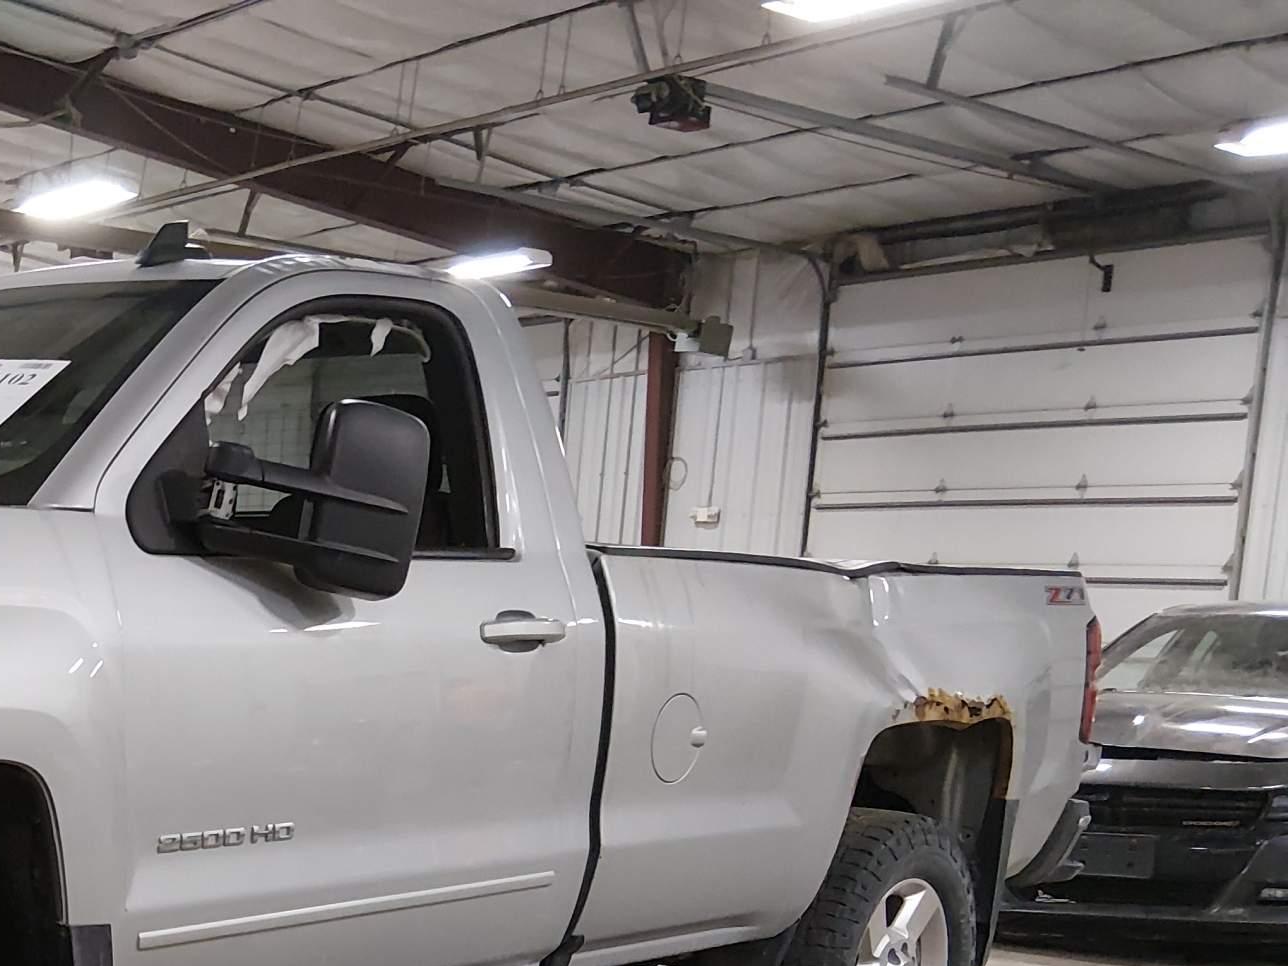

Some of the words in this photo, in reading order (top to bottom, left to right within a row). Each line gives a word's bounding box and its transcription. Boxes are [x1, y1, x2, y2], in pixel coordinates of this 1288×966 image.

[1044, 585, 1085, 605] Z71
[157, 827, 245, 854] 2500
[250, 822, 295, 844] HD
